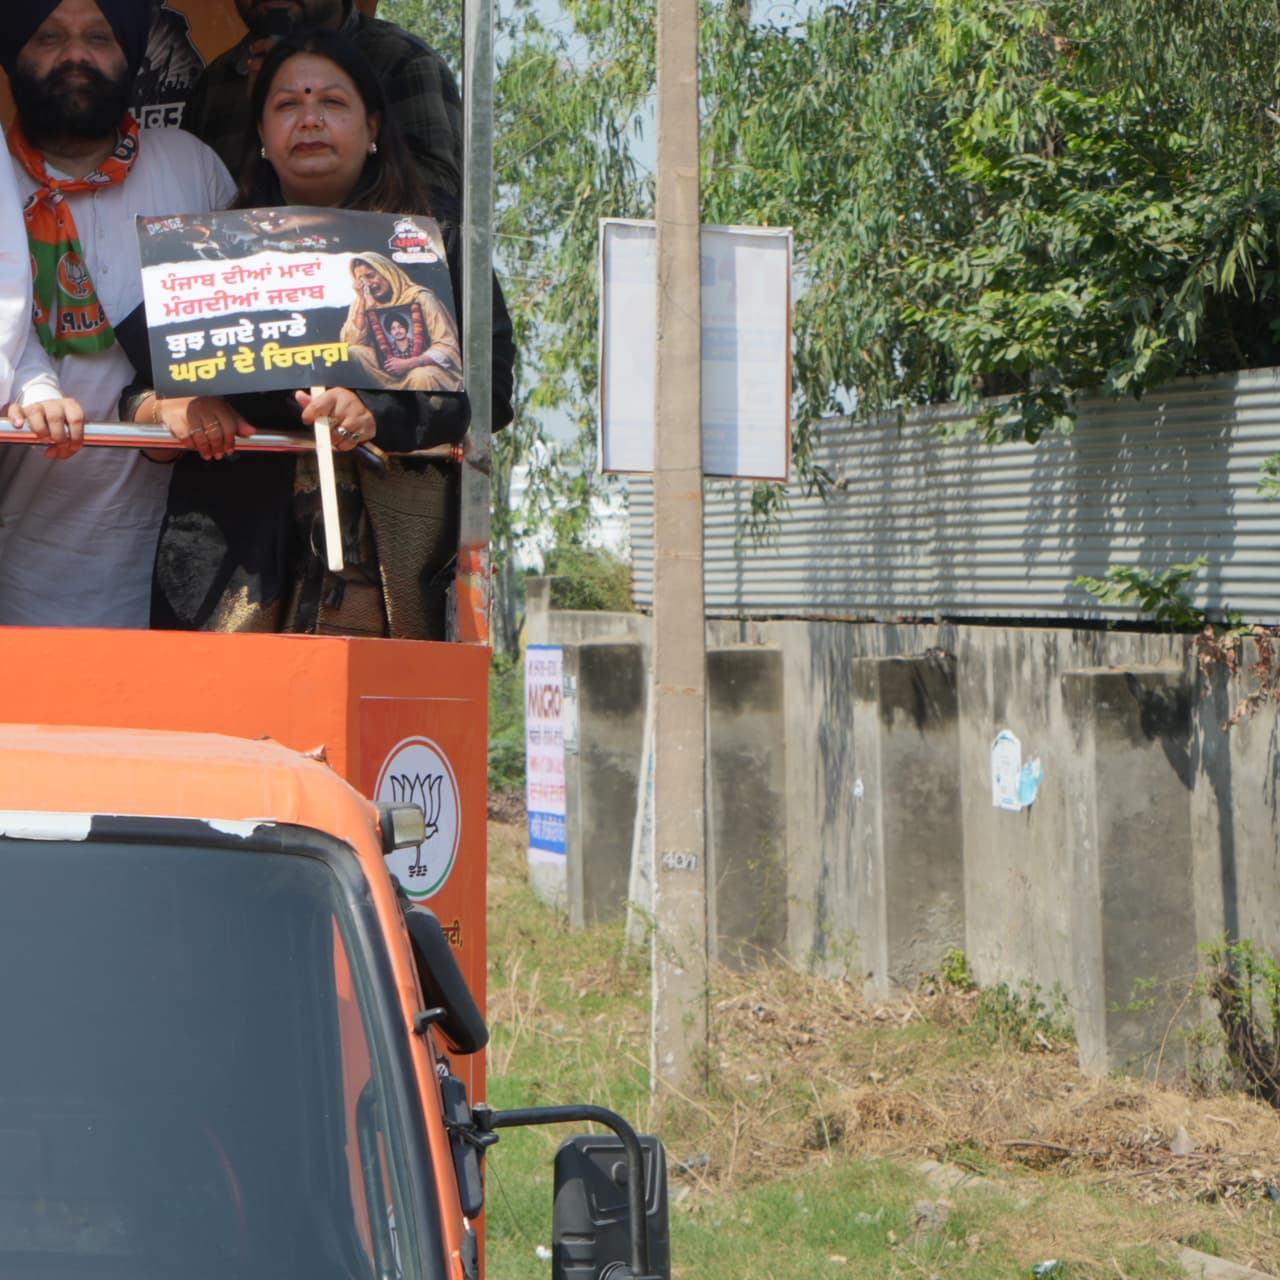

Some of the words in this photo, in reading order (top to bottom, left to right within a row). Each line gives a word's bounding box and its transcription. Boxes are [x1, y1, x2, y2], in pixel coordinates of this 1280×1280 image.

[160, 273, 216, 292] ਪੰਜਾਬ
[221, 262, 274, 285] ਦੀਆਂ
[278, 257, 322, 279] ਮਾਵਾਂ
[163, 287, 260, 318] ਮੰਗਦੀਆਂ
[266, 285, 326, 305] ਜਵਾਬ
[165, 330, 205, 359] ਬੁਝ
[209, 318, 255, 346] ਗਏ
[259, 312, 307, 339] ਸਾਡੇ
[168, 350, 227, 382] ਘਰਾਂ
[231, 345, 256, 374] ਦੇ
